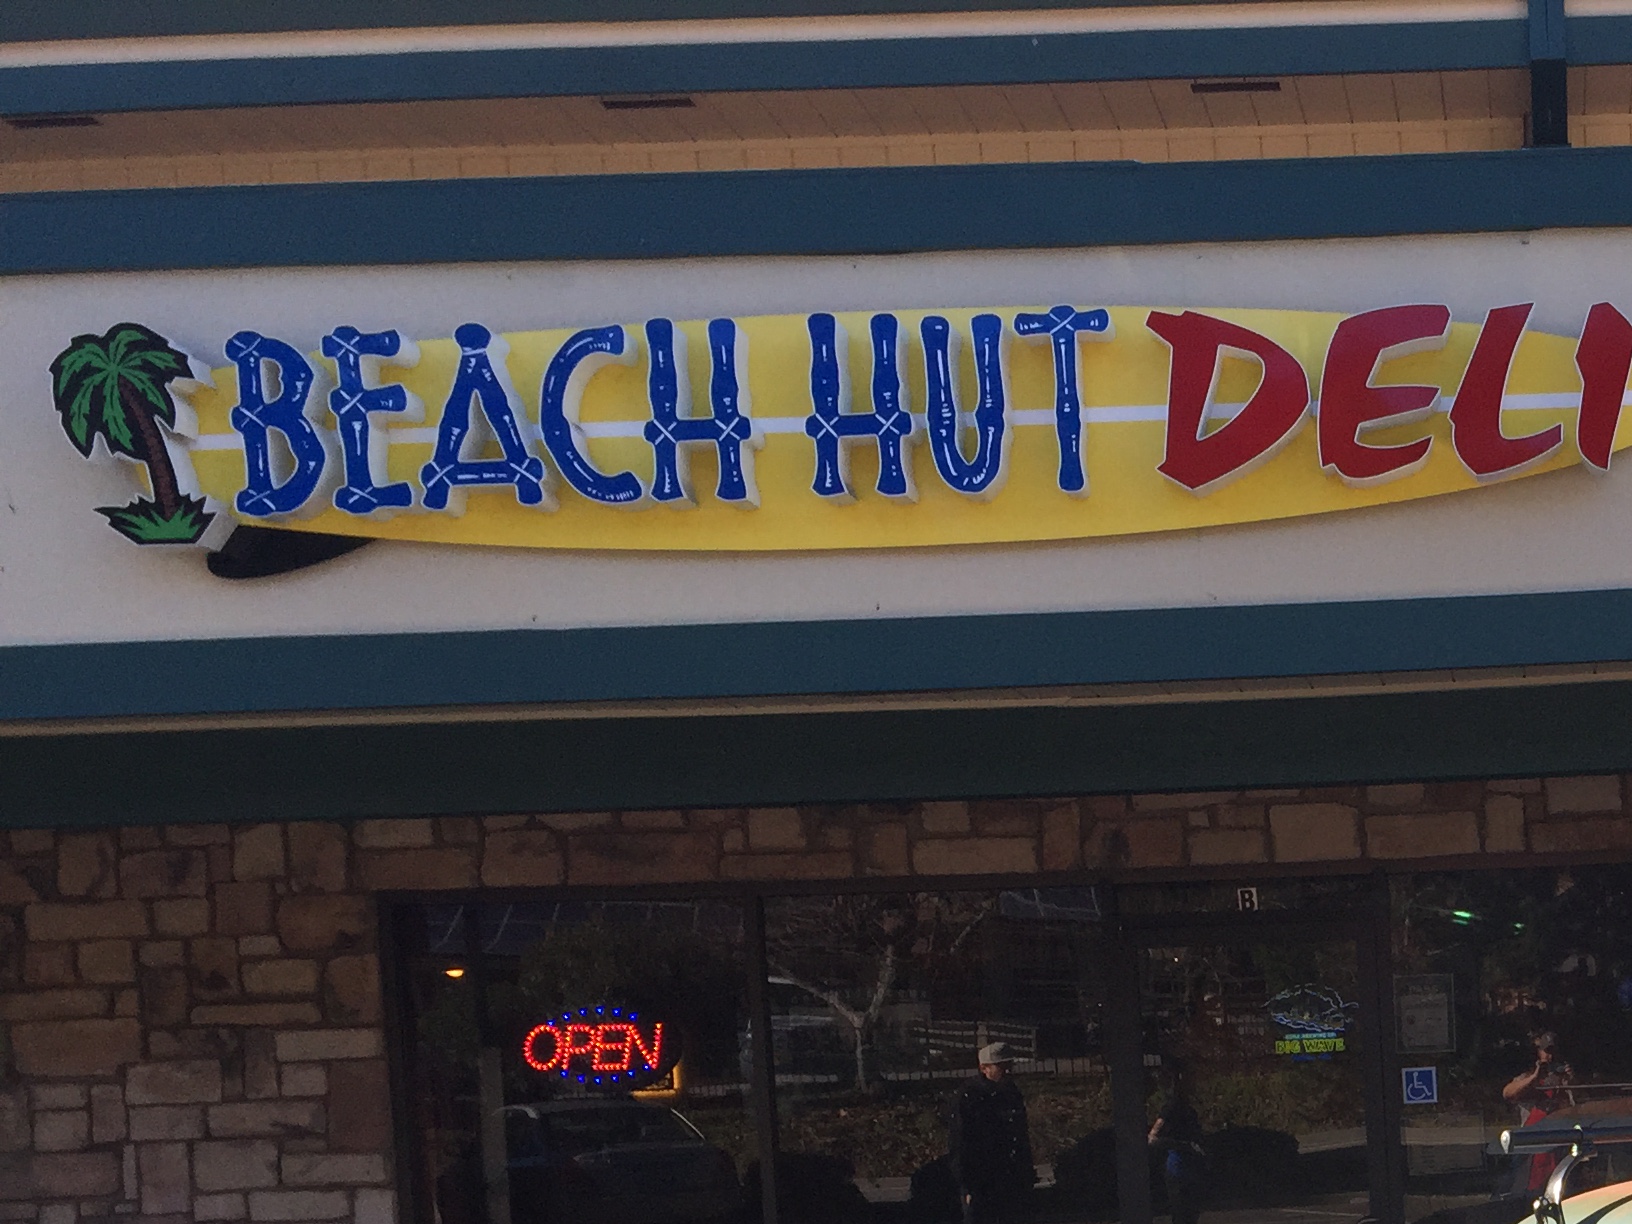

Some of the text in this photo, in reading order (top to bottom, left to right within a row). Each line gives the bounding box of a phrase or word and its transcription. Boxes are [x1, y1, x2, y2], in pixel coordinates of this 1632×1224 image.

[224, 316, 757, 518] BEACH
[803, 304, 1110, 498] HUT
[1239, 889, 1256, 911] B
[523, 1023, 663, 1071] OPEN
[1275, 1038, 1346, 1054] BIG WAVE
